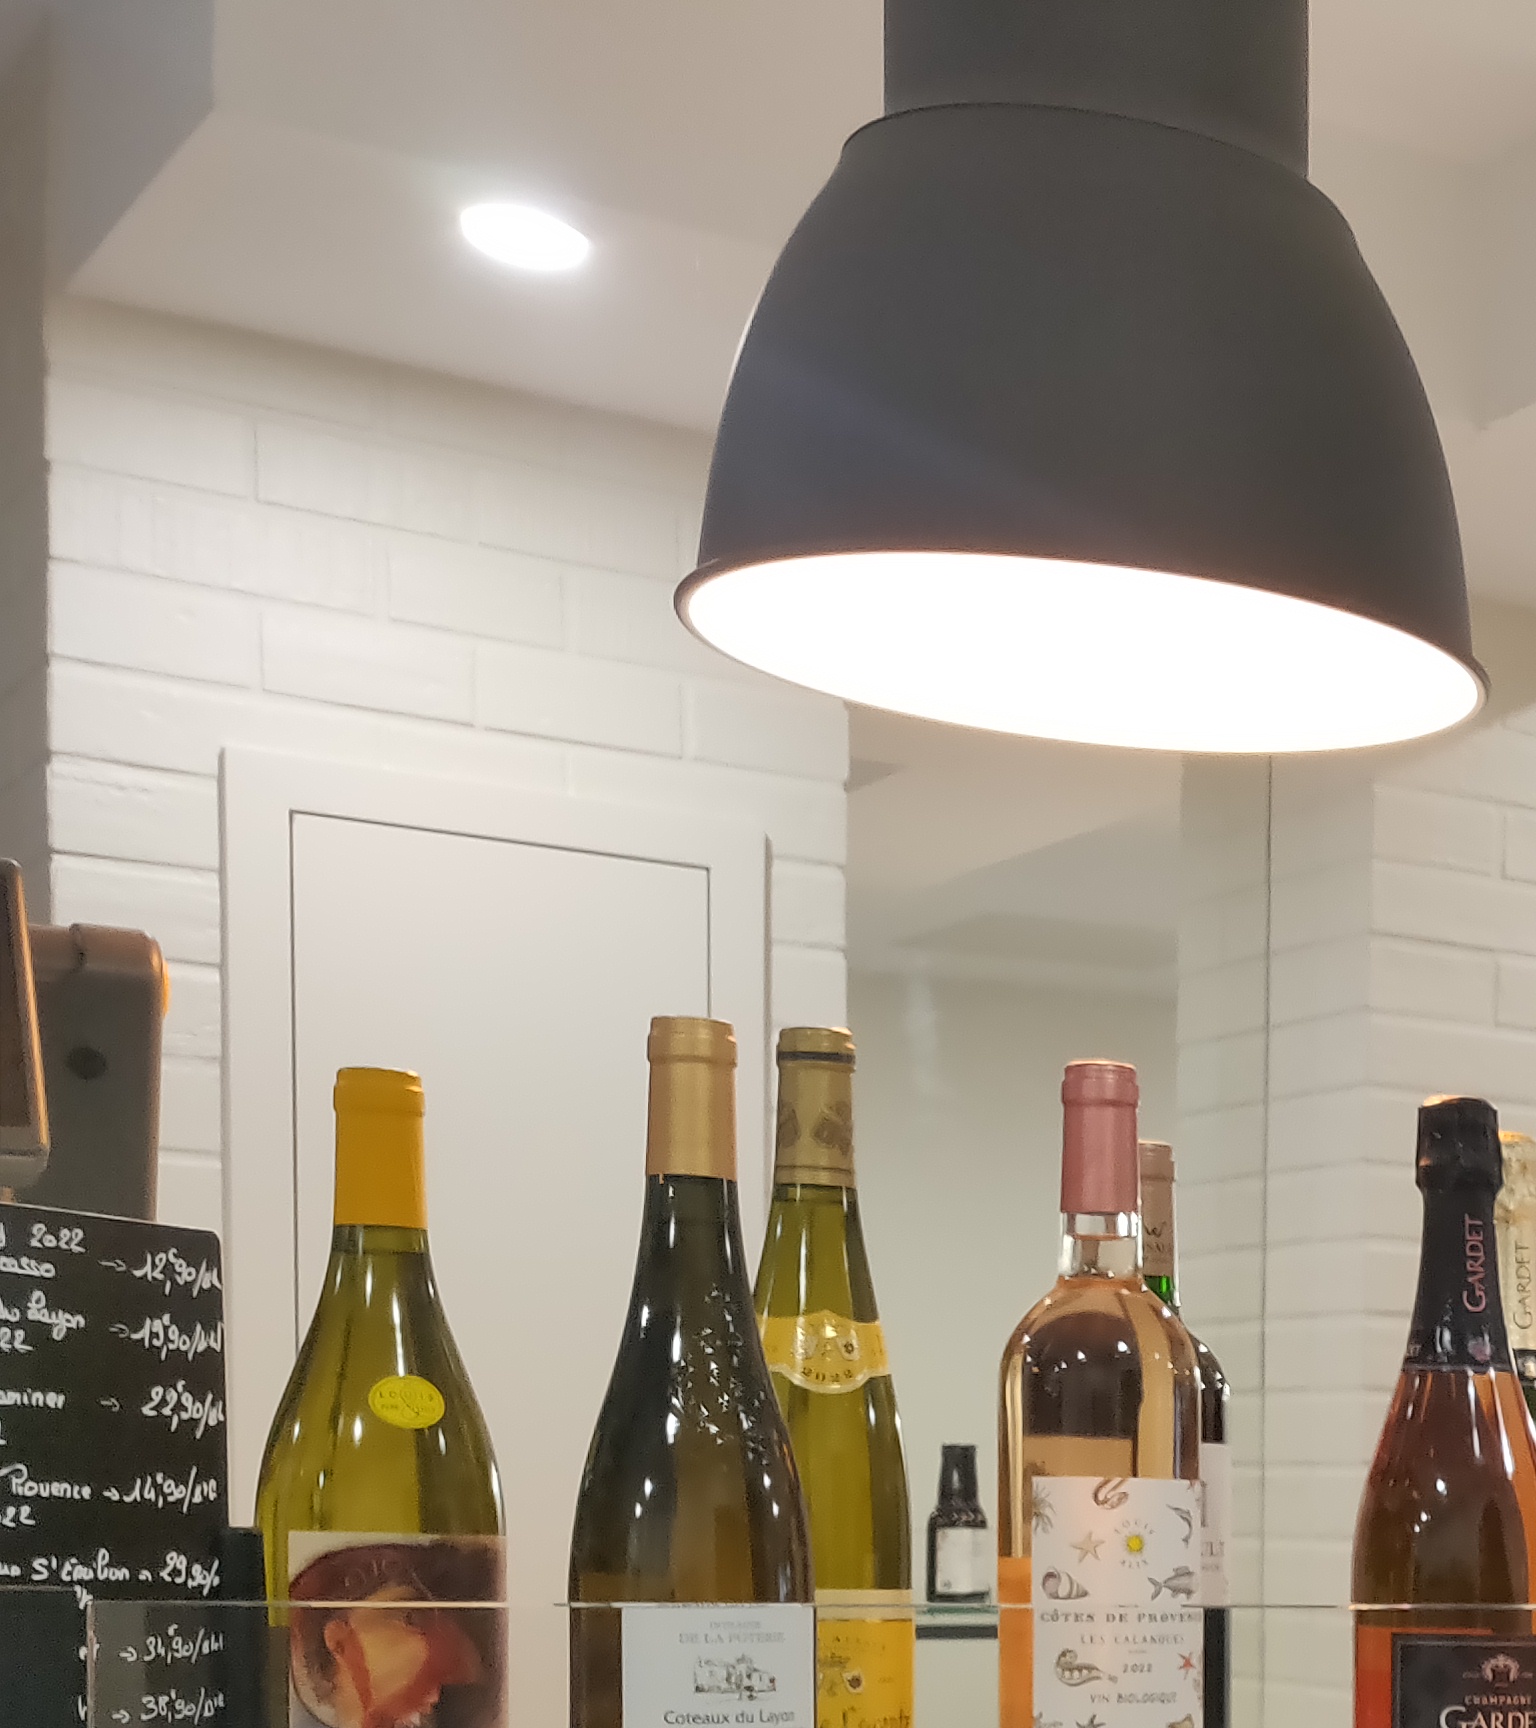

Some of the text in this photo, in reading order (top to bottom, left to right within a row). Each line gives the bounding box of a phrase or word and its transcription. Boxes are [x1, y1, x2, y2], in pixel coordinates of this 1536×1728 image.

[30, 1223, 86, 1253] 2022
[1462, 1213, 1486, 1313] GARDET
[1513, 1240, 1533, 1330] GARDET
[1106, 1612, 1129, 1624] DE
[1122, 1663, 1154, 1675] 2022
[663, 1708, 796, 1727] Coteaux du Layon
